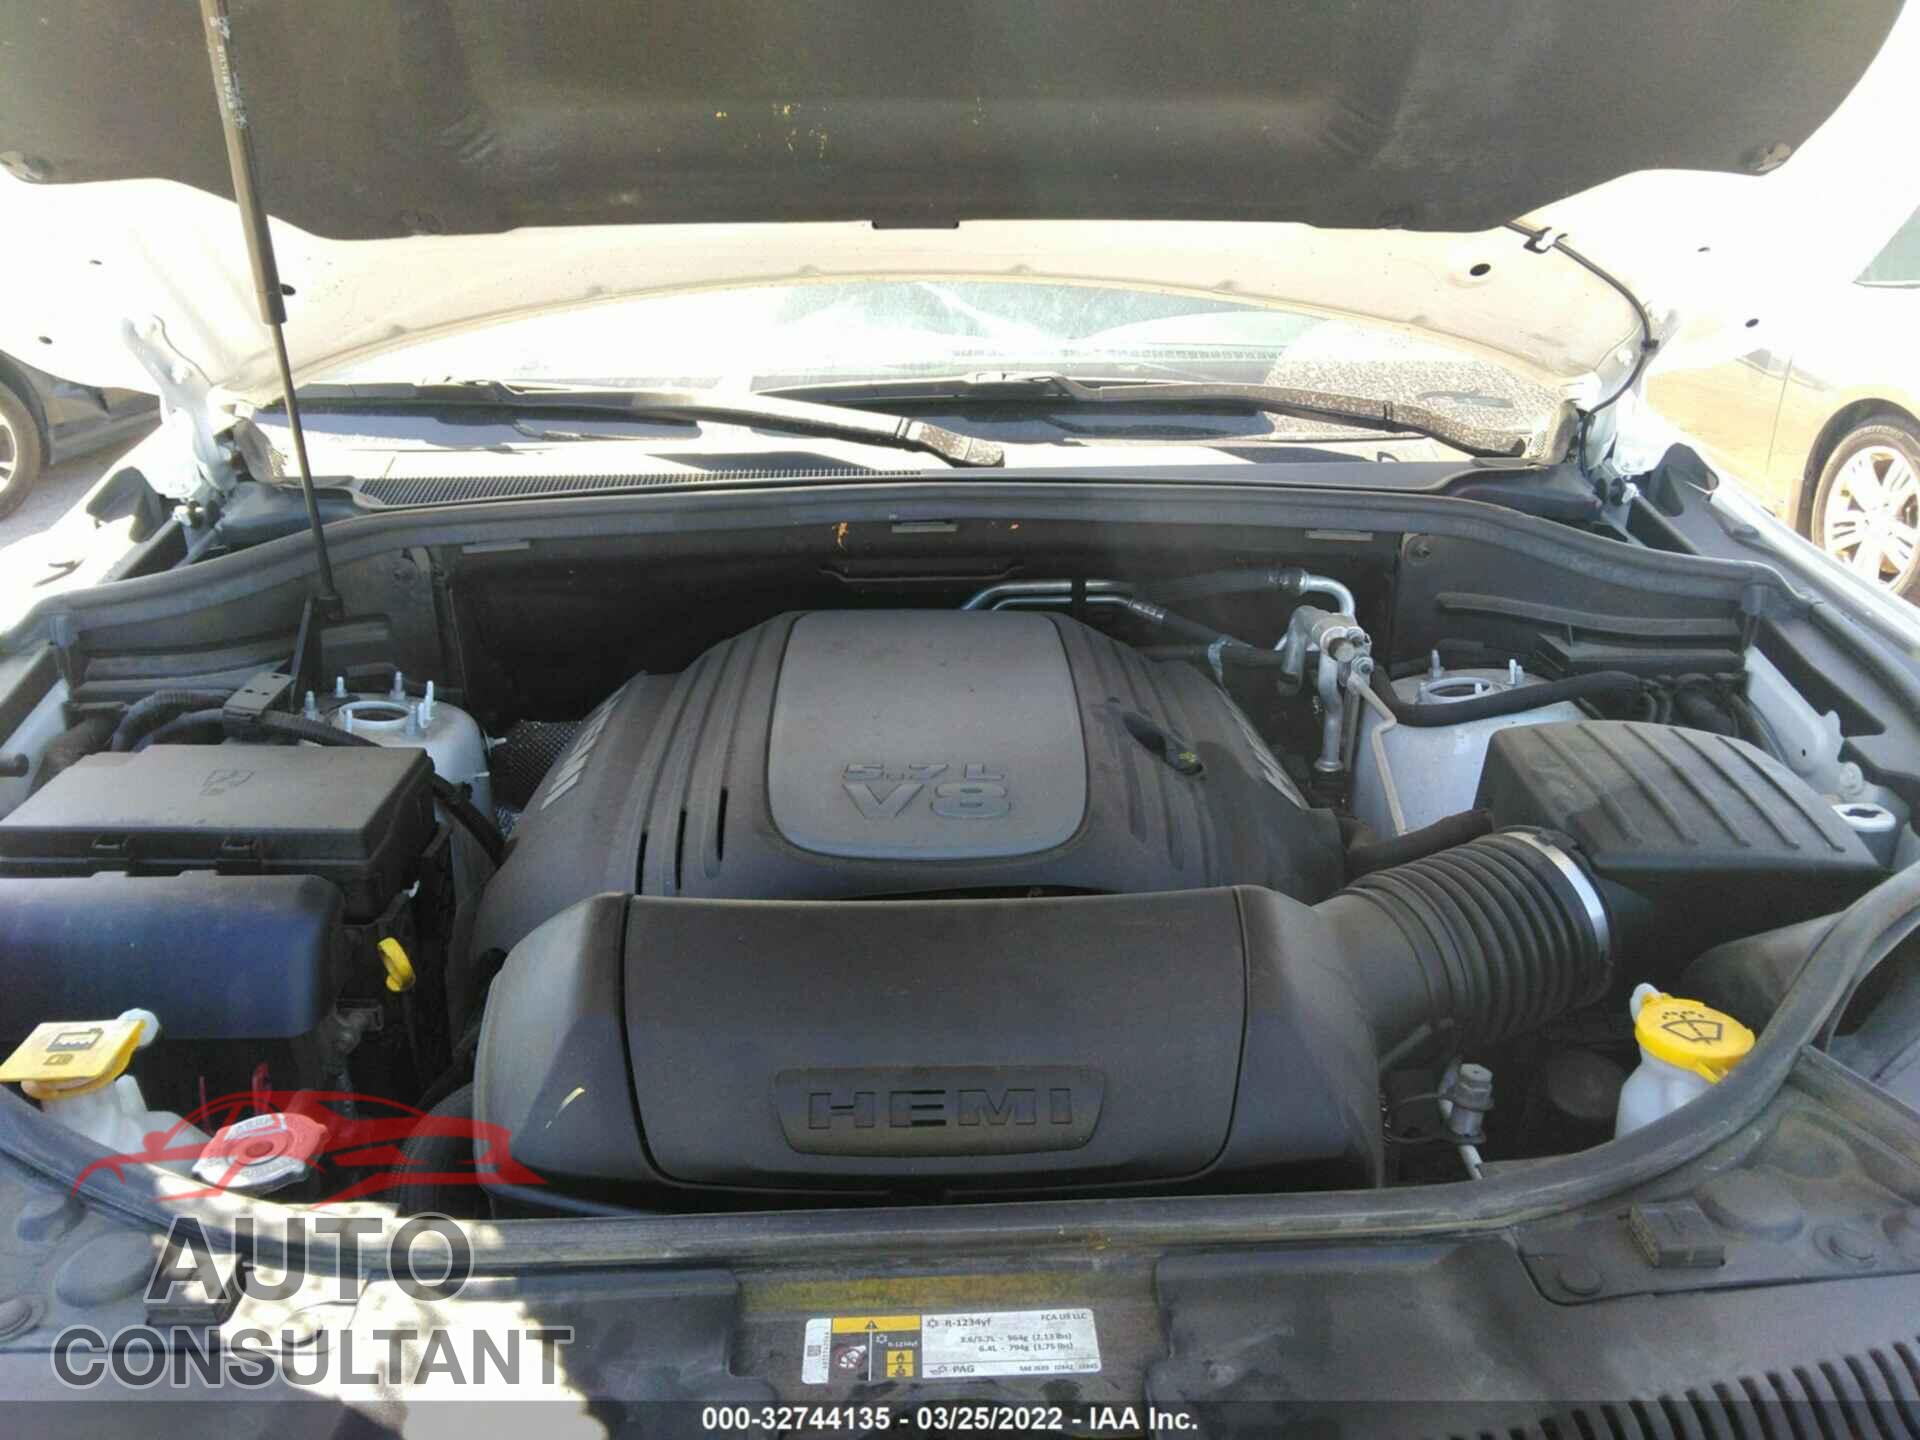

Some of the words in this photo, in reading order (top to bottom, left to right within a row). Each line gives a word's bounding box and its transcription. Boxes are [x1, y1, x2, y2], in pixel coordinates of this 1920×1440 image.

[841, 783, 1012, 820] V8
[808, 1087, 1073, 1129] HEMI
[944, 1317, 992, 1328] R-1234yf
[952, 1365, 976, 1374] PAG
